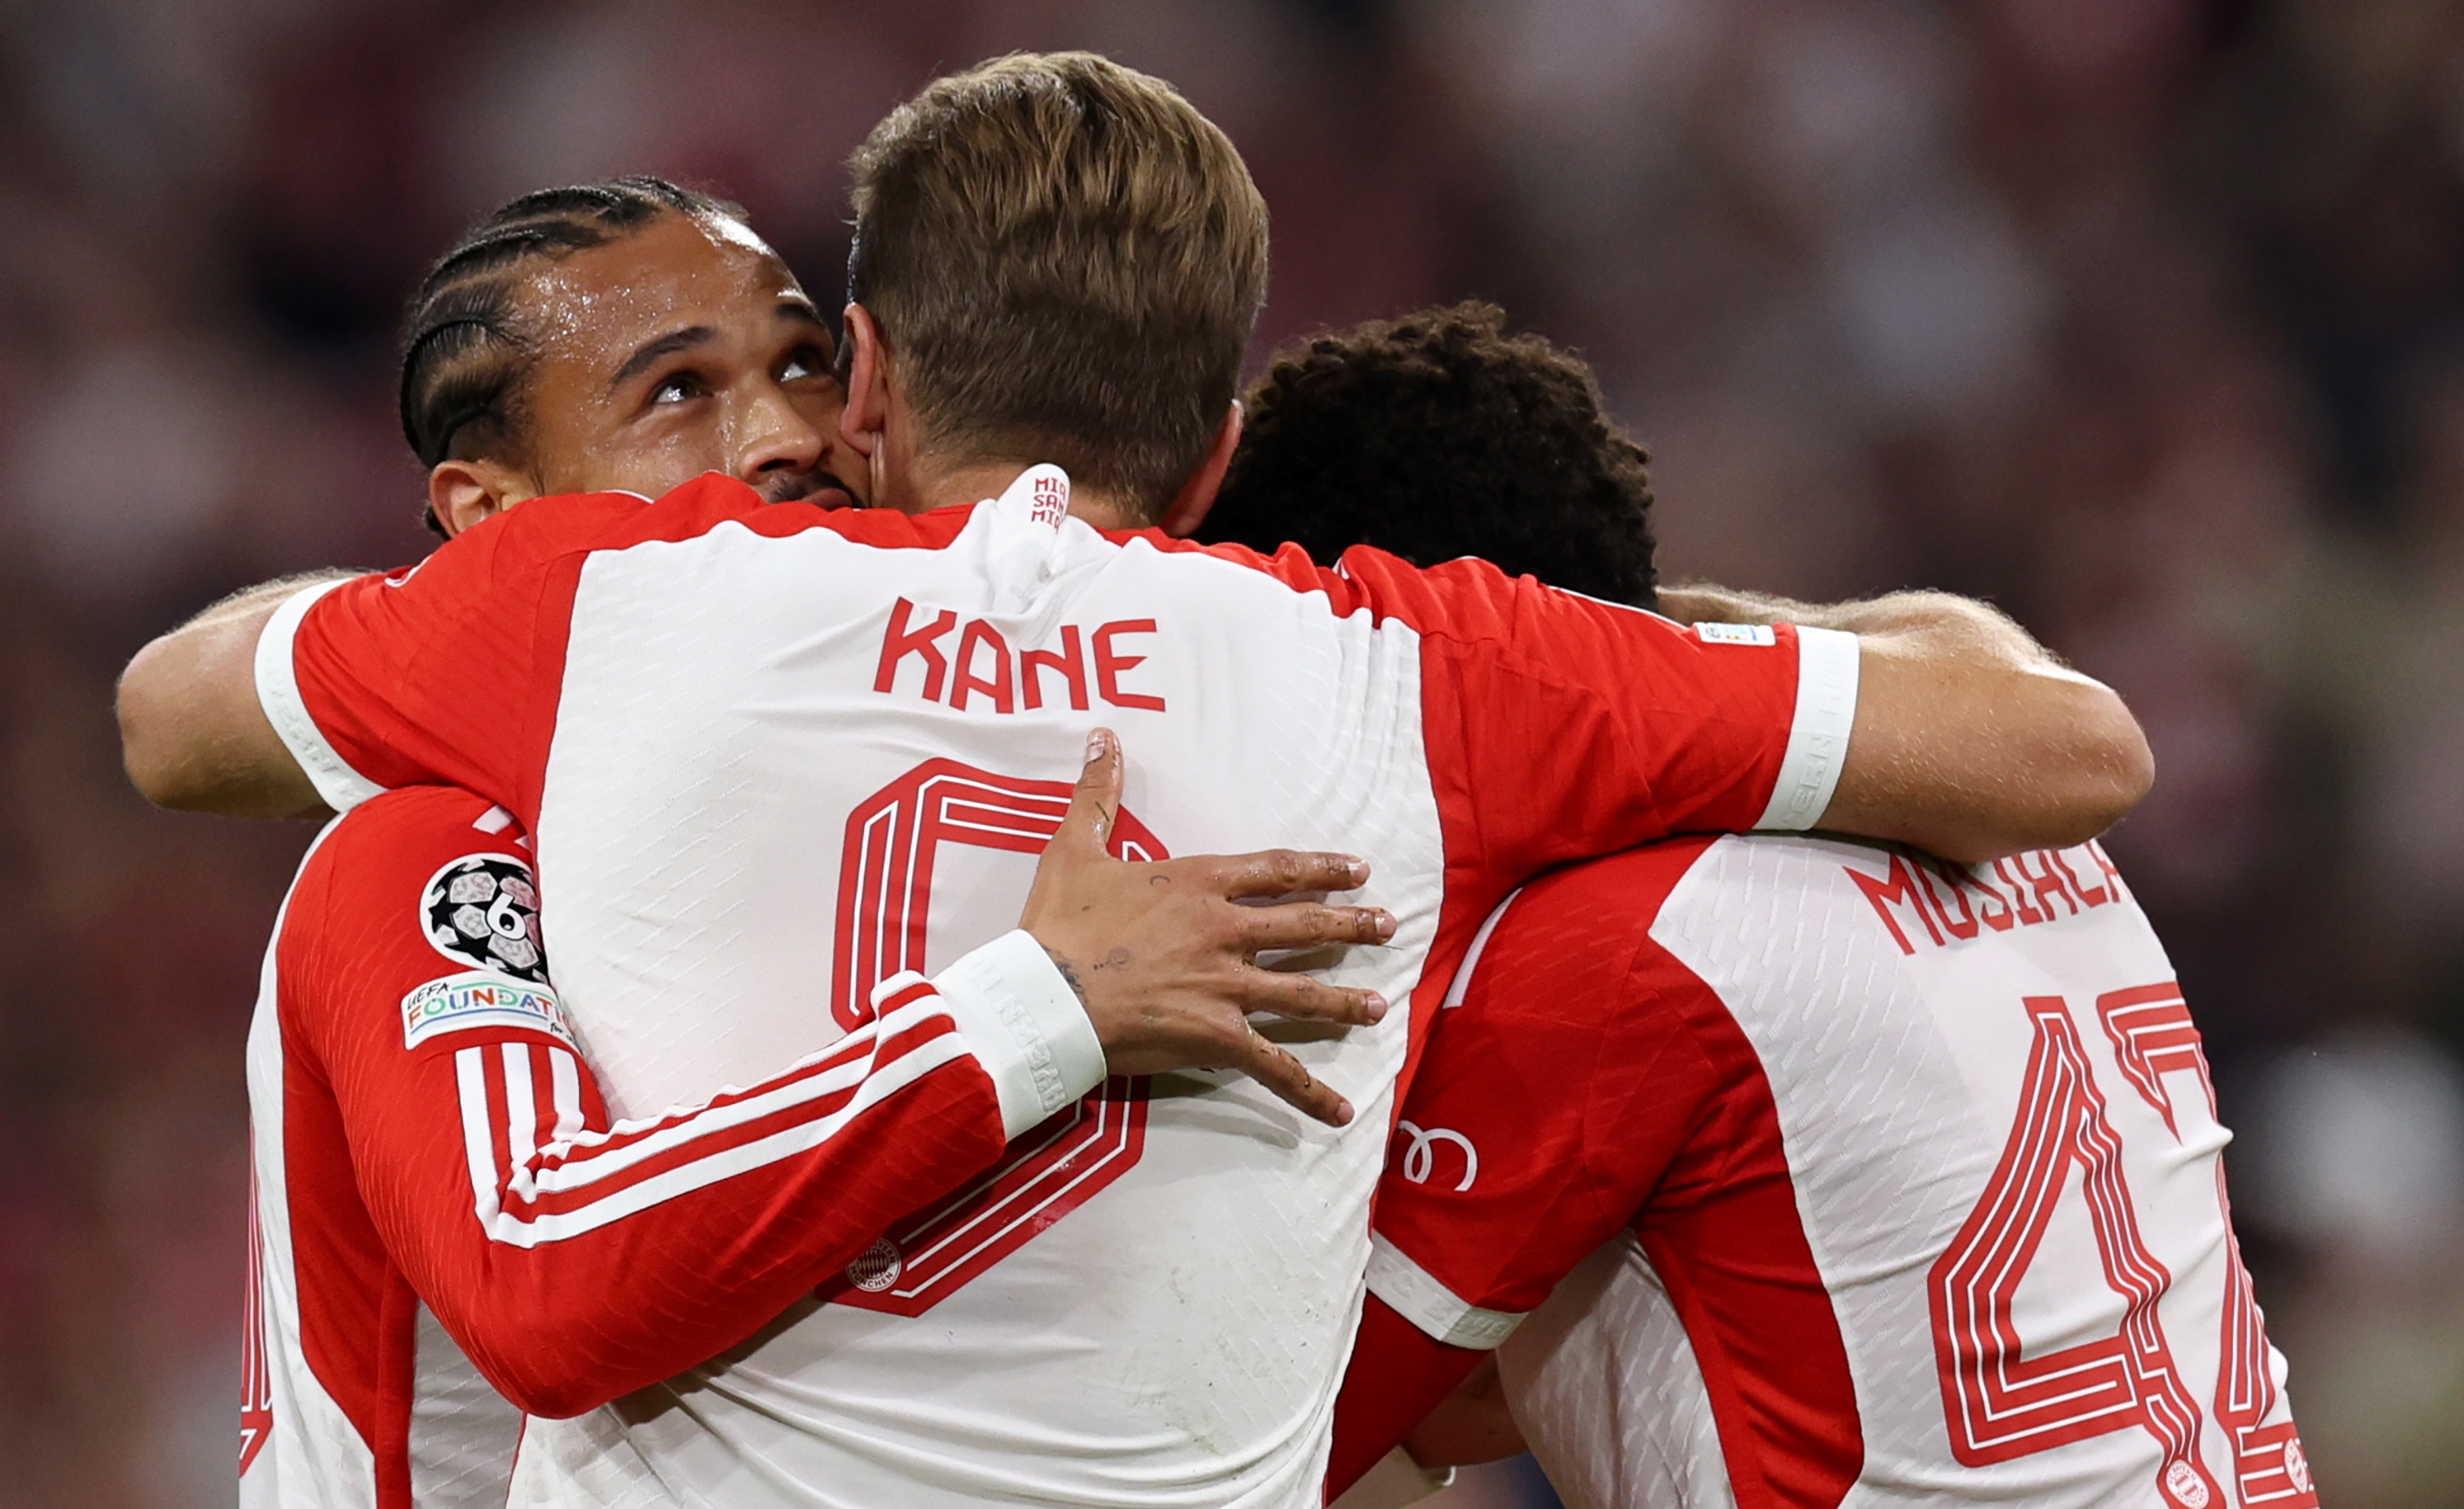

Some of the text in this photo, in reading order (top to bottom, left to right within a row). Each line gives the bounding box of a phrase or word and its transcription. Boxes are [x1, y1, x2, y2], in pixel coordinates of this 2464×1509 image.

[1035, 477, 1066, 501] MIA
[1033, 495, 1065, 519] SAN
[1031, 509, 1061, 535] MIA
[873, 596, 1166, 714] KANE
[486, 892, 526, 941] 6
[407, 982, 449, 1010] UEFA
[848, 1266, 894, 1289] MÜNCHEN
